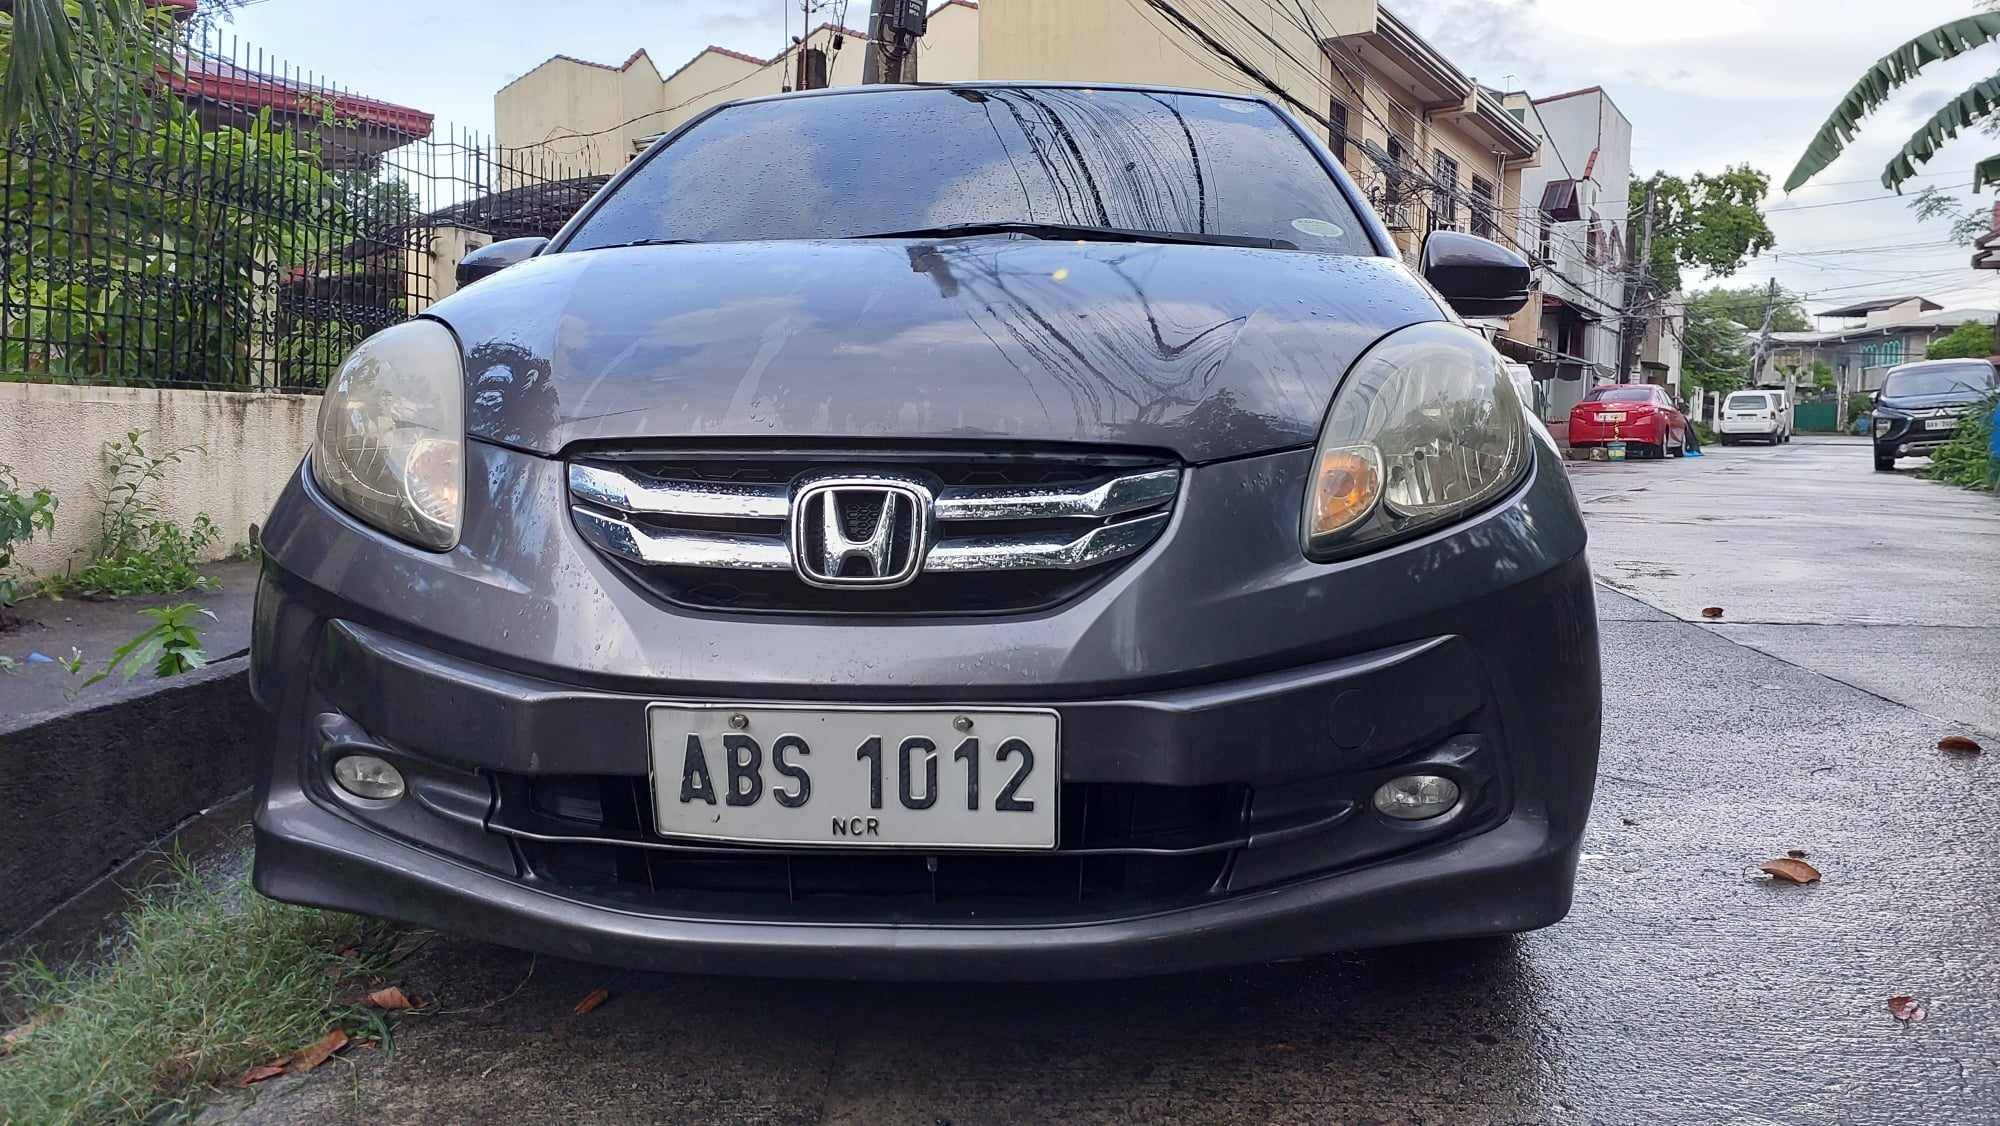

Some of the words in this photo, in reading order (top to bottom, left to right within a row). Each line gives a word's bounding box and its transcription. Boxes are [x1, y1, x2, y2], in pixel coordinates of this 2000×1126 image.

[679, 733, 813, 809] ABS
[856, 736, 1036, 813] 1012
[832, 817, 880, 836] NCR
